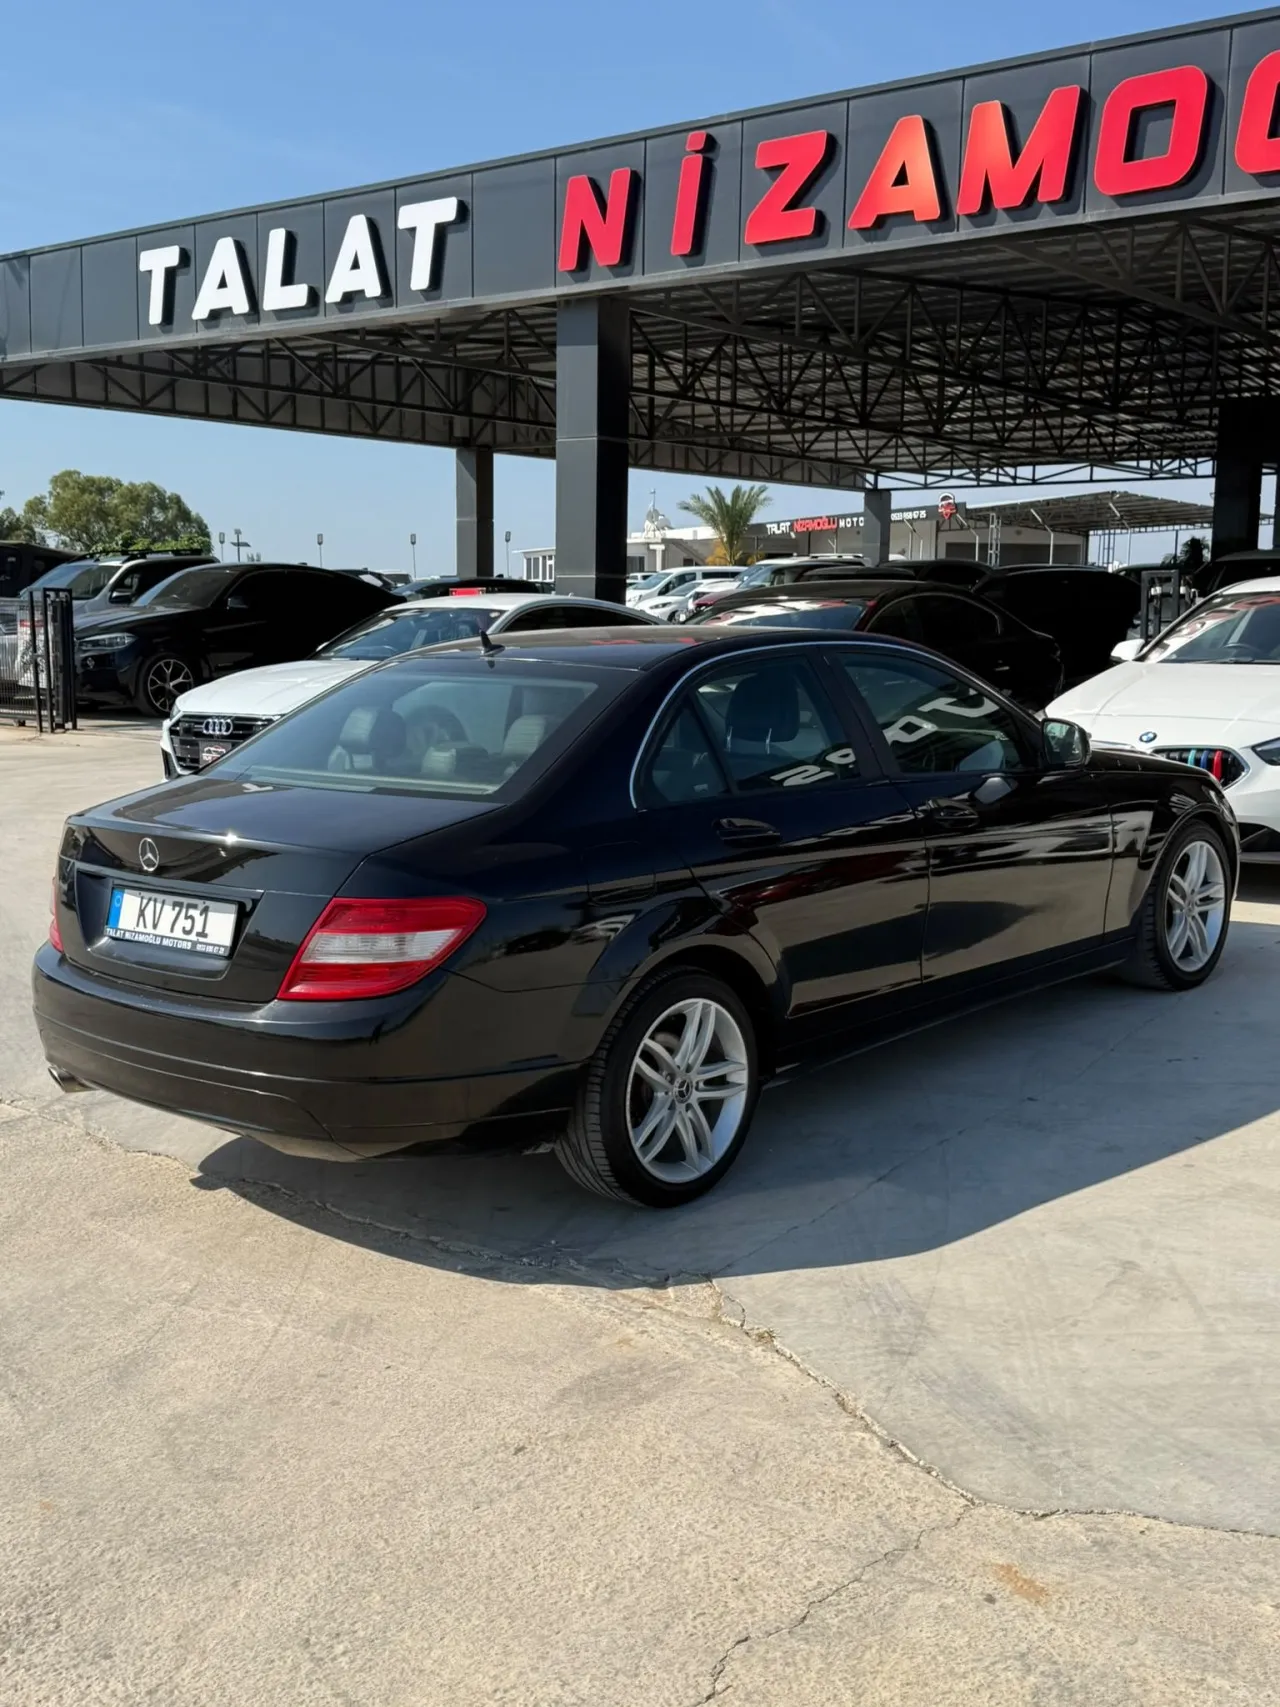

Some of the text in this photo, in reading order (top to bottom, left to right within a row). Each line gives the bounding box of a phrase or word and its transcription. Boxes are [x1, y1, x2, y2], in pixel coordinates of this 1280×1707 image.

[139, 196, 459, 326] TALAT
[766, 522, 791, 535] TALAT
[839, 516, 865, 529] MOTO
[136, 895, 210, 938] KV 751
[106, 928, 124, 938] TALAT
[162, 937, 192, 950] MOTORS
